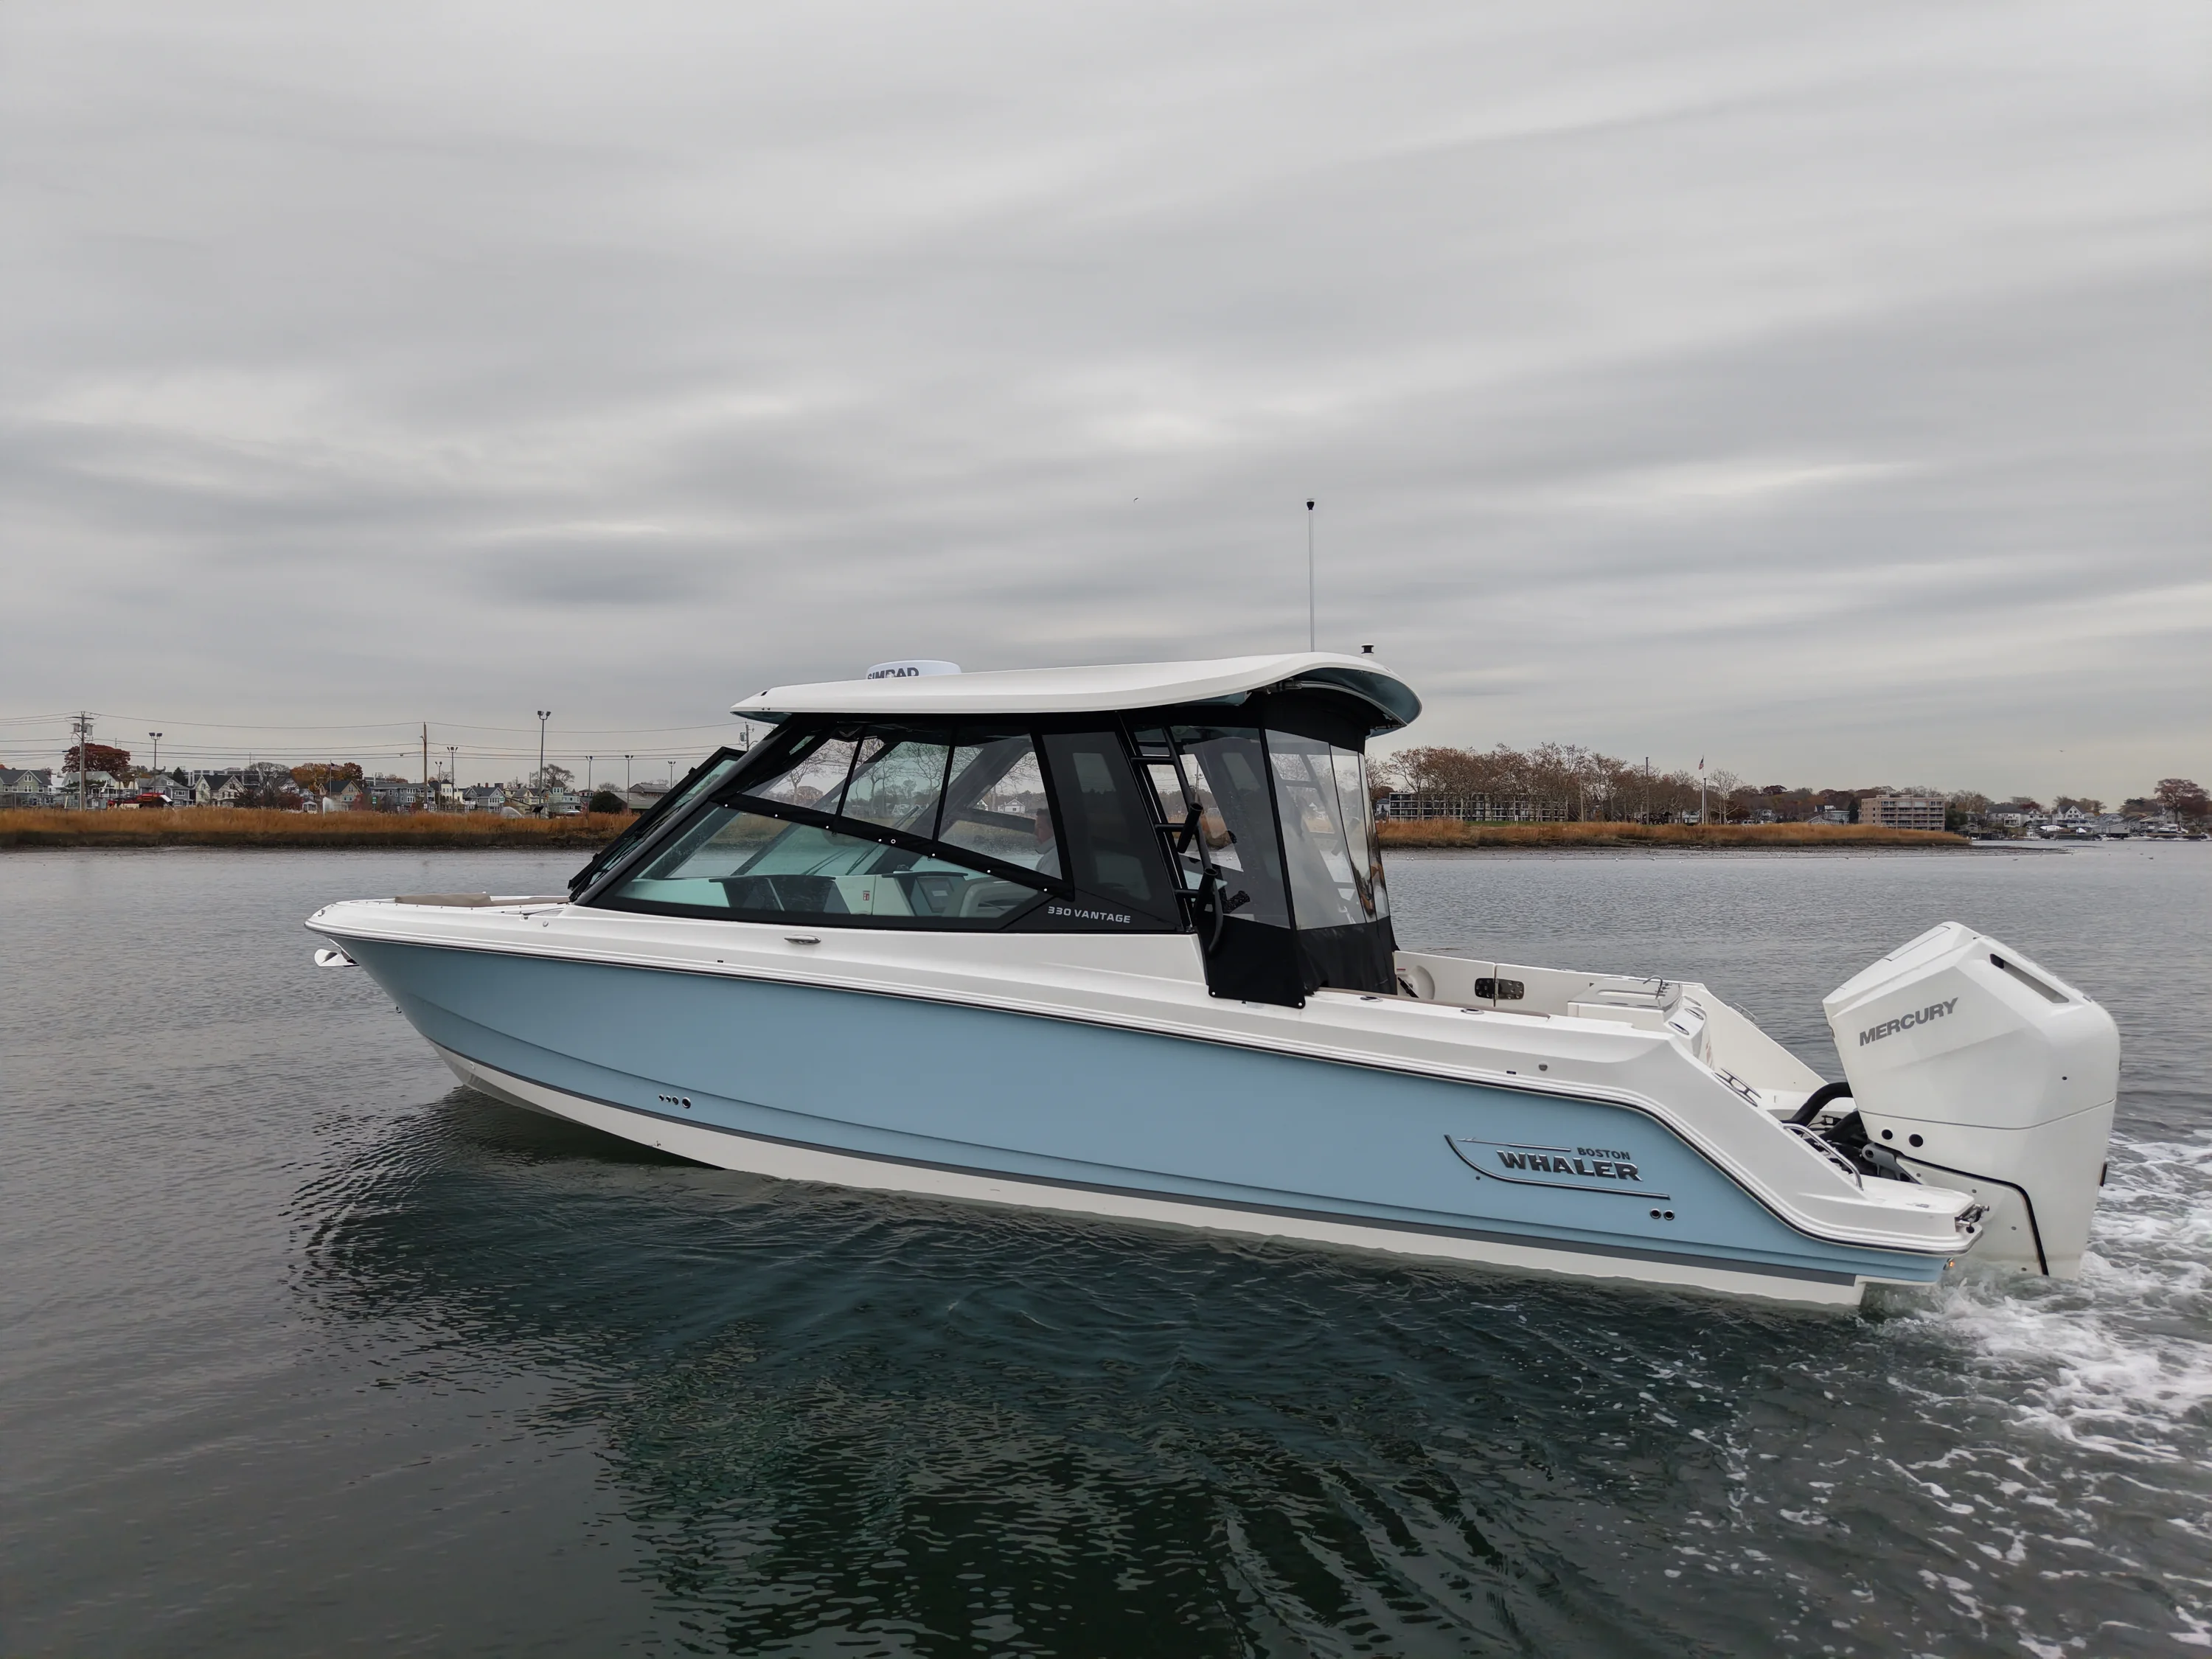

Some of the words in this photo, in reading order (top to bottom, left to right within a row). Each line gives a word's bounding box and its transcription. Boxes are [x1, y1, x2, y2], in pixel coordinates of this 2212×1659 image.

[1048, 906, 1071, 916] 330
[1074, 909, 1131, 923] VANTAGE
[1860, 997, 1958, 1046] MERCURY
[1496, 1150, 1643, 1182] WHALER
[1577, 1147, 1630, 1161] BOSTON
